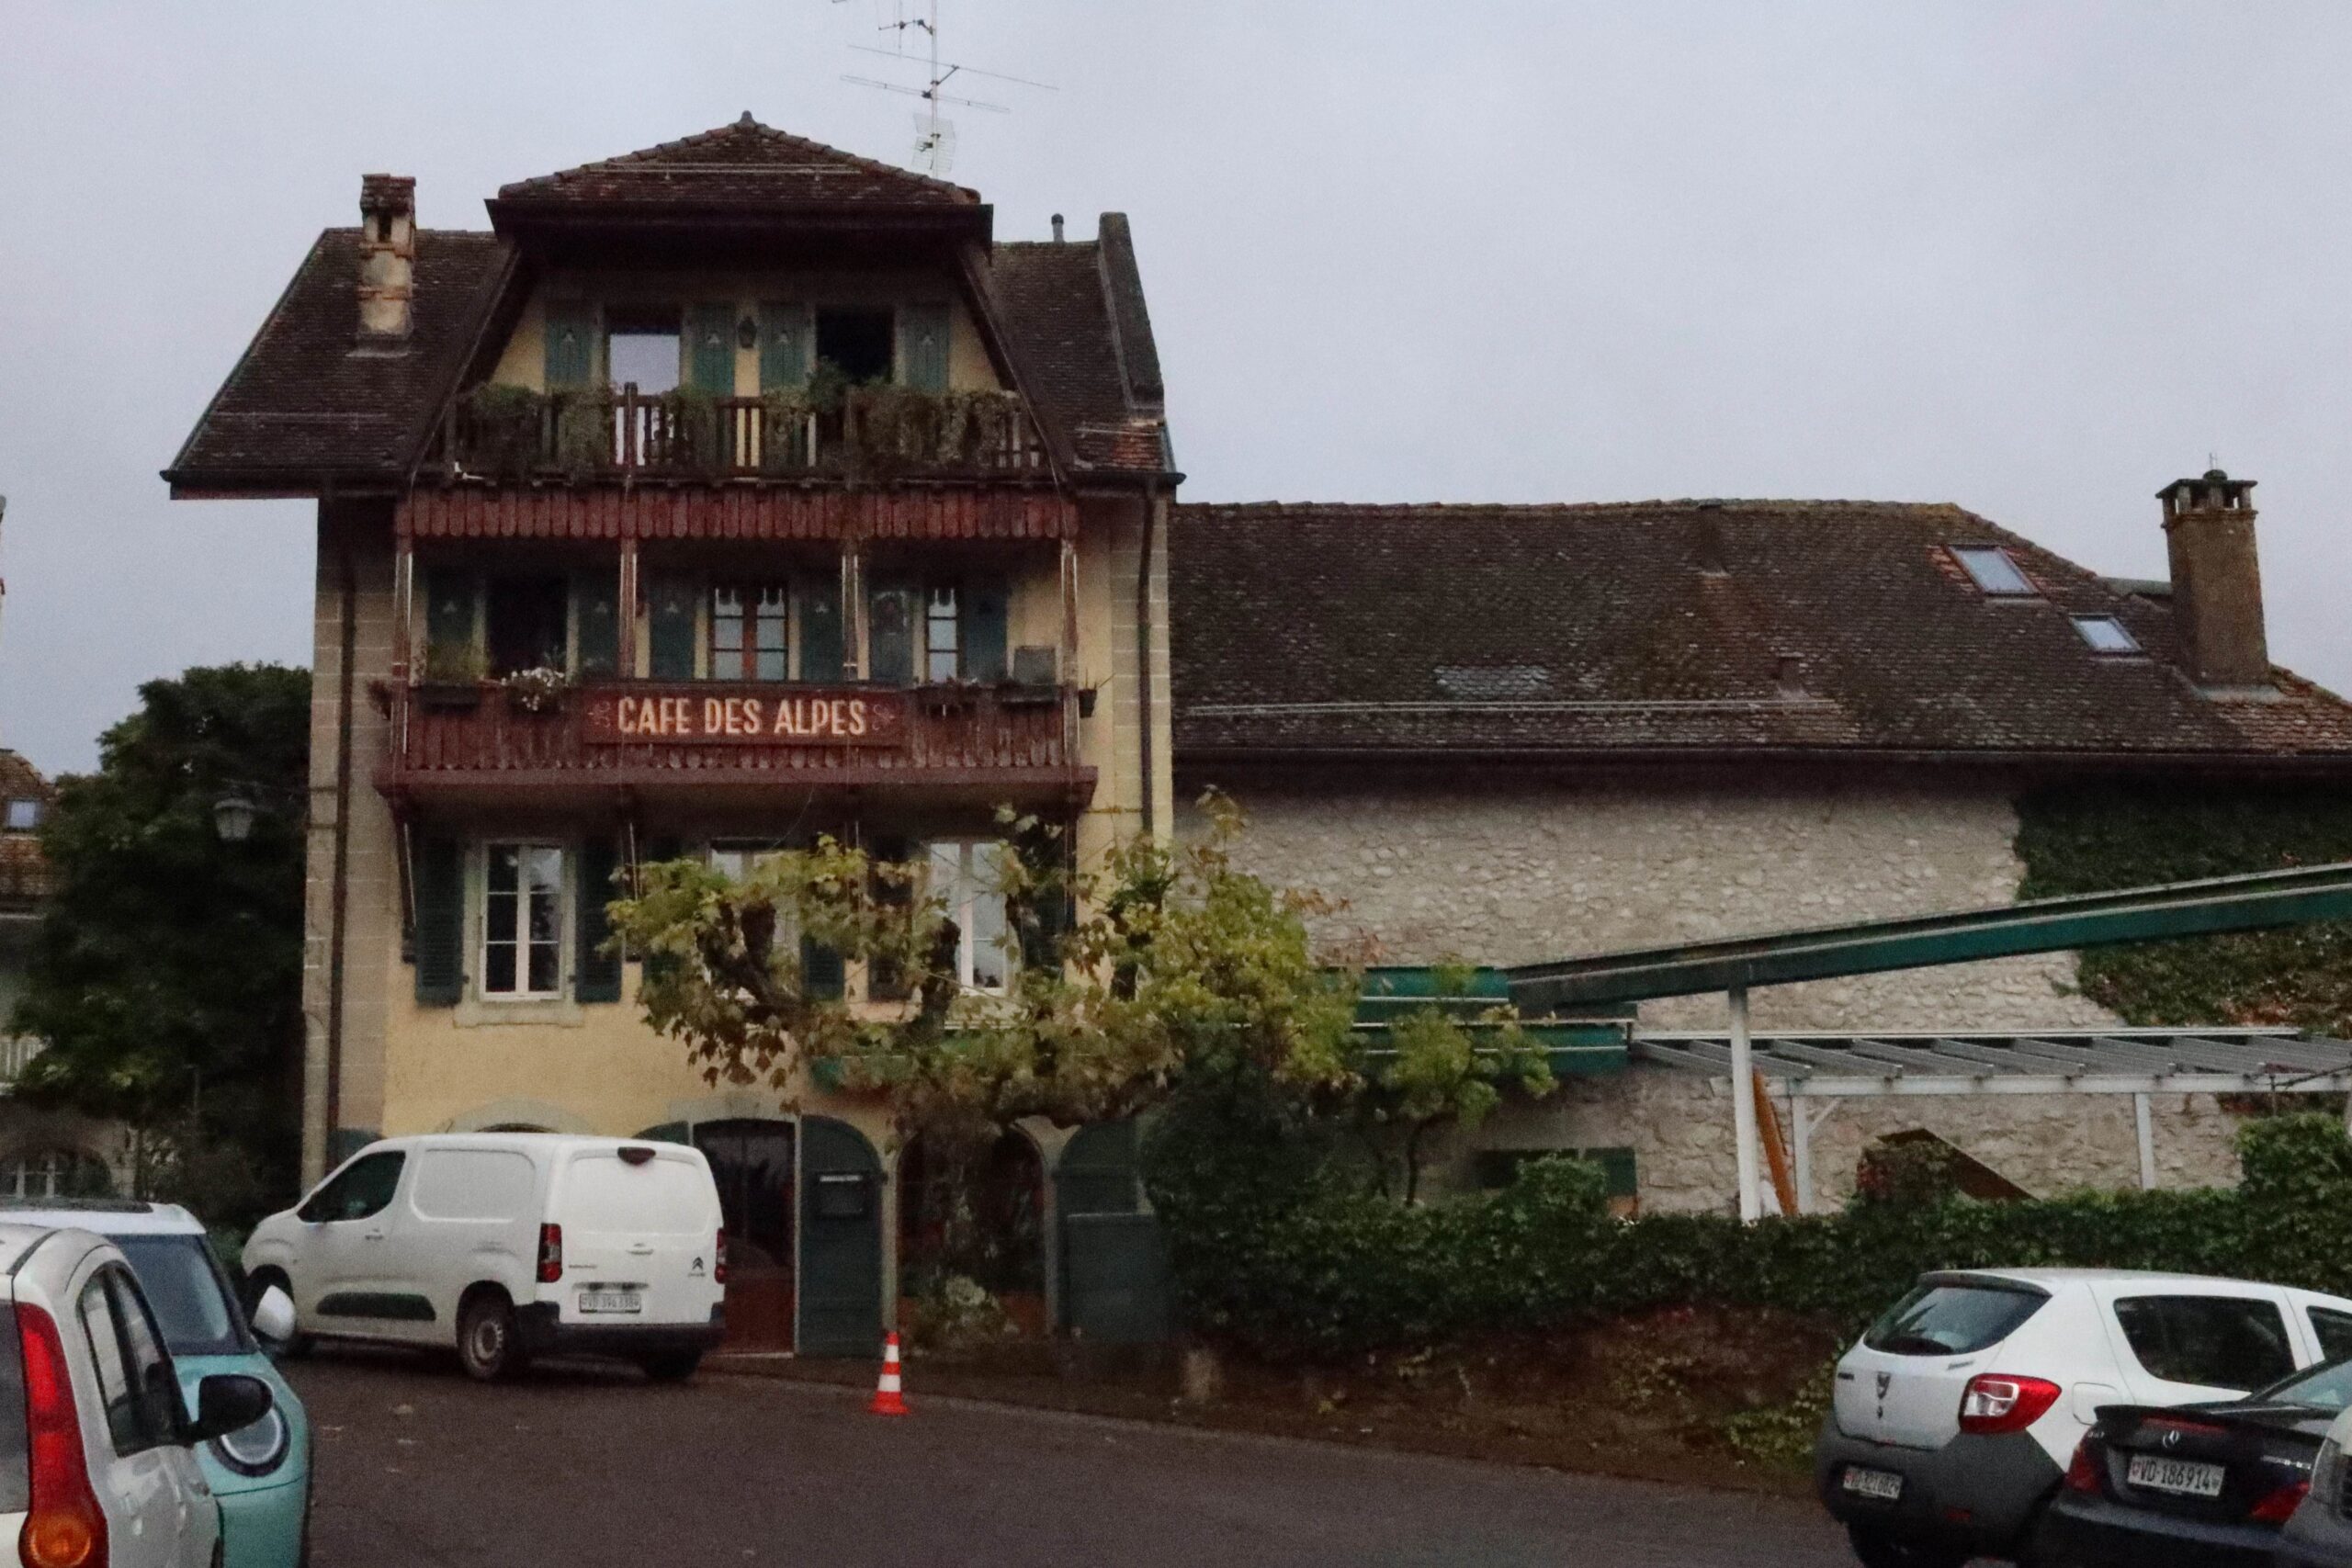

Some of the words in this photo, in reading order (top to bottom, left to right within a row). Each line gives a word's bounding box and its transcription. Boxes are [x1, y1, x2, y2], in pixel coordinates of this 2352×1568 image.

[617, 696, 691, 734] CAFE
[704, 697, 762, 735] DES
[774, 699, 867, 735] ALPES
